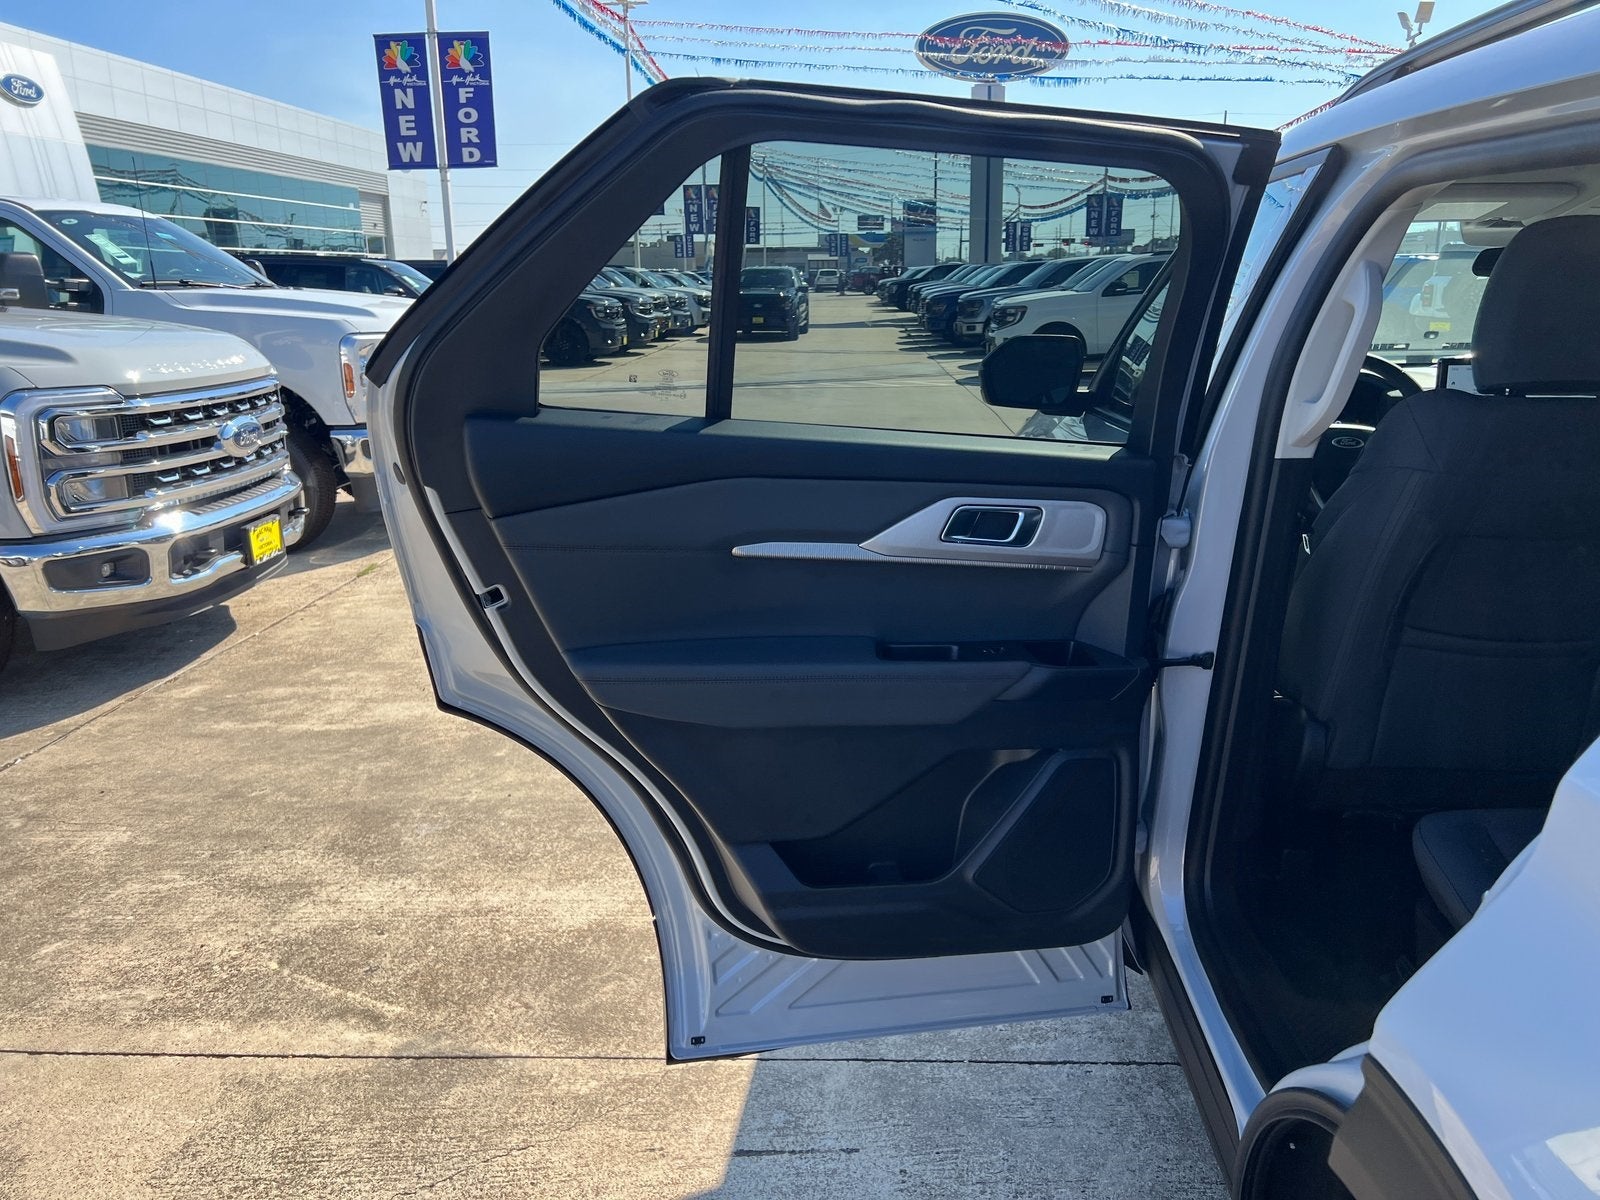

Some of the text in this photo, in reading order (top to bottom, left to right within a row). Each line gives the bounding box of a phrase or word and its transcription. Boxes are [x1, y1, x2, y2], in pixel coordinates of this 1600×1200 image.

[950, 26, 1039, 65] Ford
[10, 78, 37, 98] Ford
[394, 88, 423, 163] NEW
[457, 88, 481, 163] FORD
[689, 204, 700, 232] NEW
[1089, 211, 1098, 235] NEW
[1110, 211, 1118, 235] FORD
